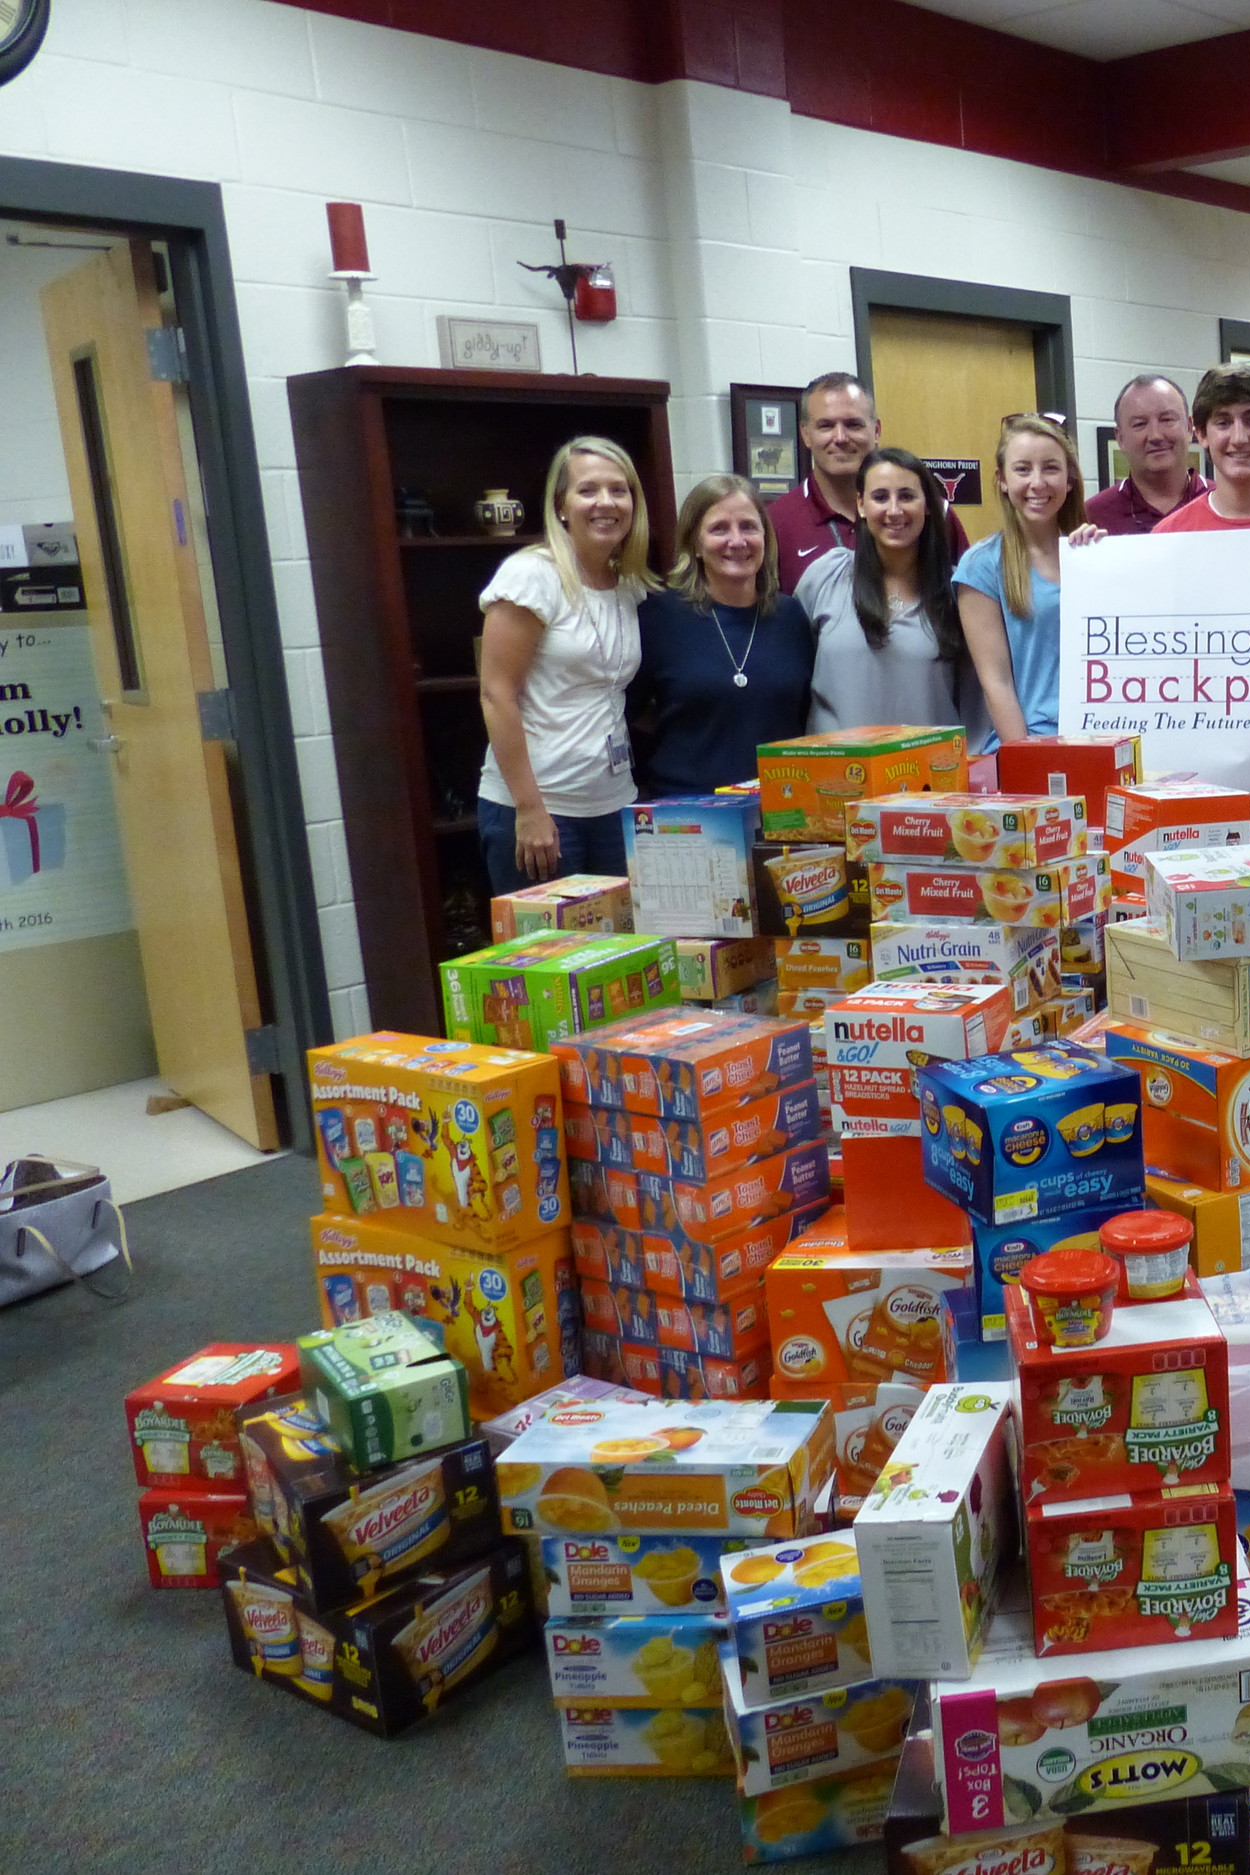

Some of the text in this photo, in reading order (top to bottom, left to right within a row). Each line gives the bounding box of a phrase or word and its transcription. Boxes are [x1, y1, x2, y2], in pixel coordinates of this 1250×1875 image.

[1081, 712, 1148, 733] Feeding
[1154, 712, 1186, 730] The
[1192, 712, 1250, 730] Future
[763, 764, 810, 782] Annie's
[885, 758, 920, 783] Annie's
[905, 817, 931, 828] Cherry
[1045, 825, 1061, 835] Cherry
[893, 827, 943, 837] Mixed Fruit
[1163, 828, 1200, 843] nutella
[785, 866, 836, 895] Velveeta
[851, 879, 868, 892] 12
[932, 878, 960, 888] Cherry
[920, 887, 974, 898] Mixed Fruit
[18, 912, 52, 927] 2016
[897, 941, 981, 964] Nutri Grain
[834, 1017, 924, 1043] nutella
[777, 1042, 800, 1056] Peanut
[837, 1041, 879, 1064] &GO!
[726, 1057, 753, 1073] Toast
[780, 1053, 800, 1066] Butter
[843, 1069, 902, 1084] 12 PACK
[313, 1083, 421, 1110] Assortment Pack
[844, 1084, 878, 1092] HAZELNUT
[458, 1105, 476, 1121] 30
[785, 1101, 807, 1115] Peanut
[733, 1116, 760, 1131] Toast
[786, 1110, 807, 1124] Butter
[842, 1119, 888, 1131] nutella
[791, 1160, 815, 1174] Peanut
[793, 1170, 815, 1184] Butter
[950, 1169, 974, 1200] easy
[1040, 1172, 1074, 1192] cups
[736, 1177, 765, 1195] Toast
[1064, 1175, 1113, 1197] easy
[744, 1236, 772, 1253] Toast
[319, 1250, 440, 1278] Assortment Pack
[484, 1274, 501, 1288] 30
[890, 1298, 940, 1316] Goldfish
[784, 1349, 816, 1362] Goldfish
[905, 1359, 934, 1369] Cheddar
[554, 1412, 601, 1422] Del Monte
[1053, 1405, 1112, 1425] BOYARDEE
[1207, 1410, 1216, 1420] 8
[1132, 1423, 1211, 1440] VARIETY PACK
[1129, 1436, 1215, 1464] BOYARDEE
[455, 1486, 478, 1506] 12
[734, 1497, 779, 1509] Del Monte
[354, 1486, 431, 1546] Velveeta
[614, 1501, 720, 1515] Diced Peaches
[382, 1523, 431, 1560] ORIGINAL
[564, 1542, 610, 1560] Dole
[570, 1565, 628, 1577] Mandarin
[1065, 1559, 1123, 1577] BOYARDEE
[571, 1576, 621, 1587] Oranges
[1143, 1578, 1224, 1592] VARIETY PACK
[500, 1591, 518, 1610] 12
[1141, 1590, 1227, 1615] BOYARDEE
[247, 1608, 288, 1631] Velveeta
[762, 1617, 813, 1639] Dole
[419, 1598, 482, 1664] Velveeta
[552, 1634, 601, 1654] Dole
[769, 1635, 832, 1658] Mandarin
[770, 1649, 824, 1668] Oranges
[554, 1672, 607, 1683] Pineapple
[566, 1708, 613, 1723] Dole
[764, 1707, 813, 1729] Dole
[770, 1724, 834, 1746] Mandarin
[1090, 1726, 1188, 1752] ORGANIC
[567, 1741, 619, 1752] Pineapple
[771, 1739, 826, 1759] Oranges
[959, 1764, 997, 1780] TOPS!
[1090, 1758, 1188, 1790] MOTT'S
[968, 1780, 991, 1791] BOX
[972, 1795, 990, 1819] 3
[1176, 1842, 1211, 1866] 12
[1156, 1864, 1235, 1874] MICROWAVEABLE
